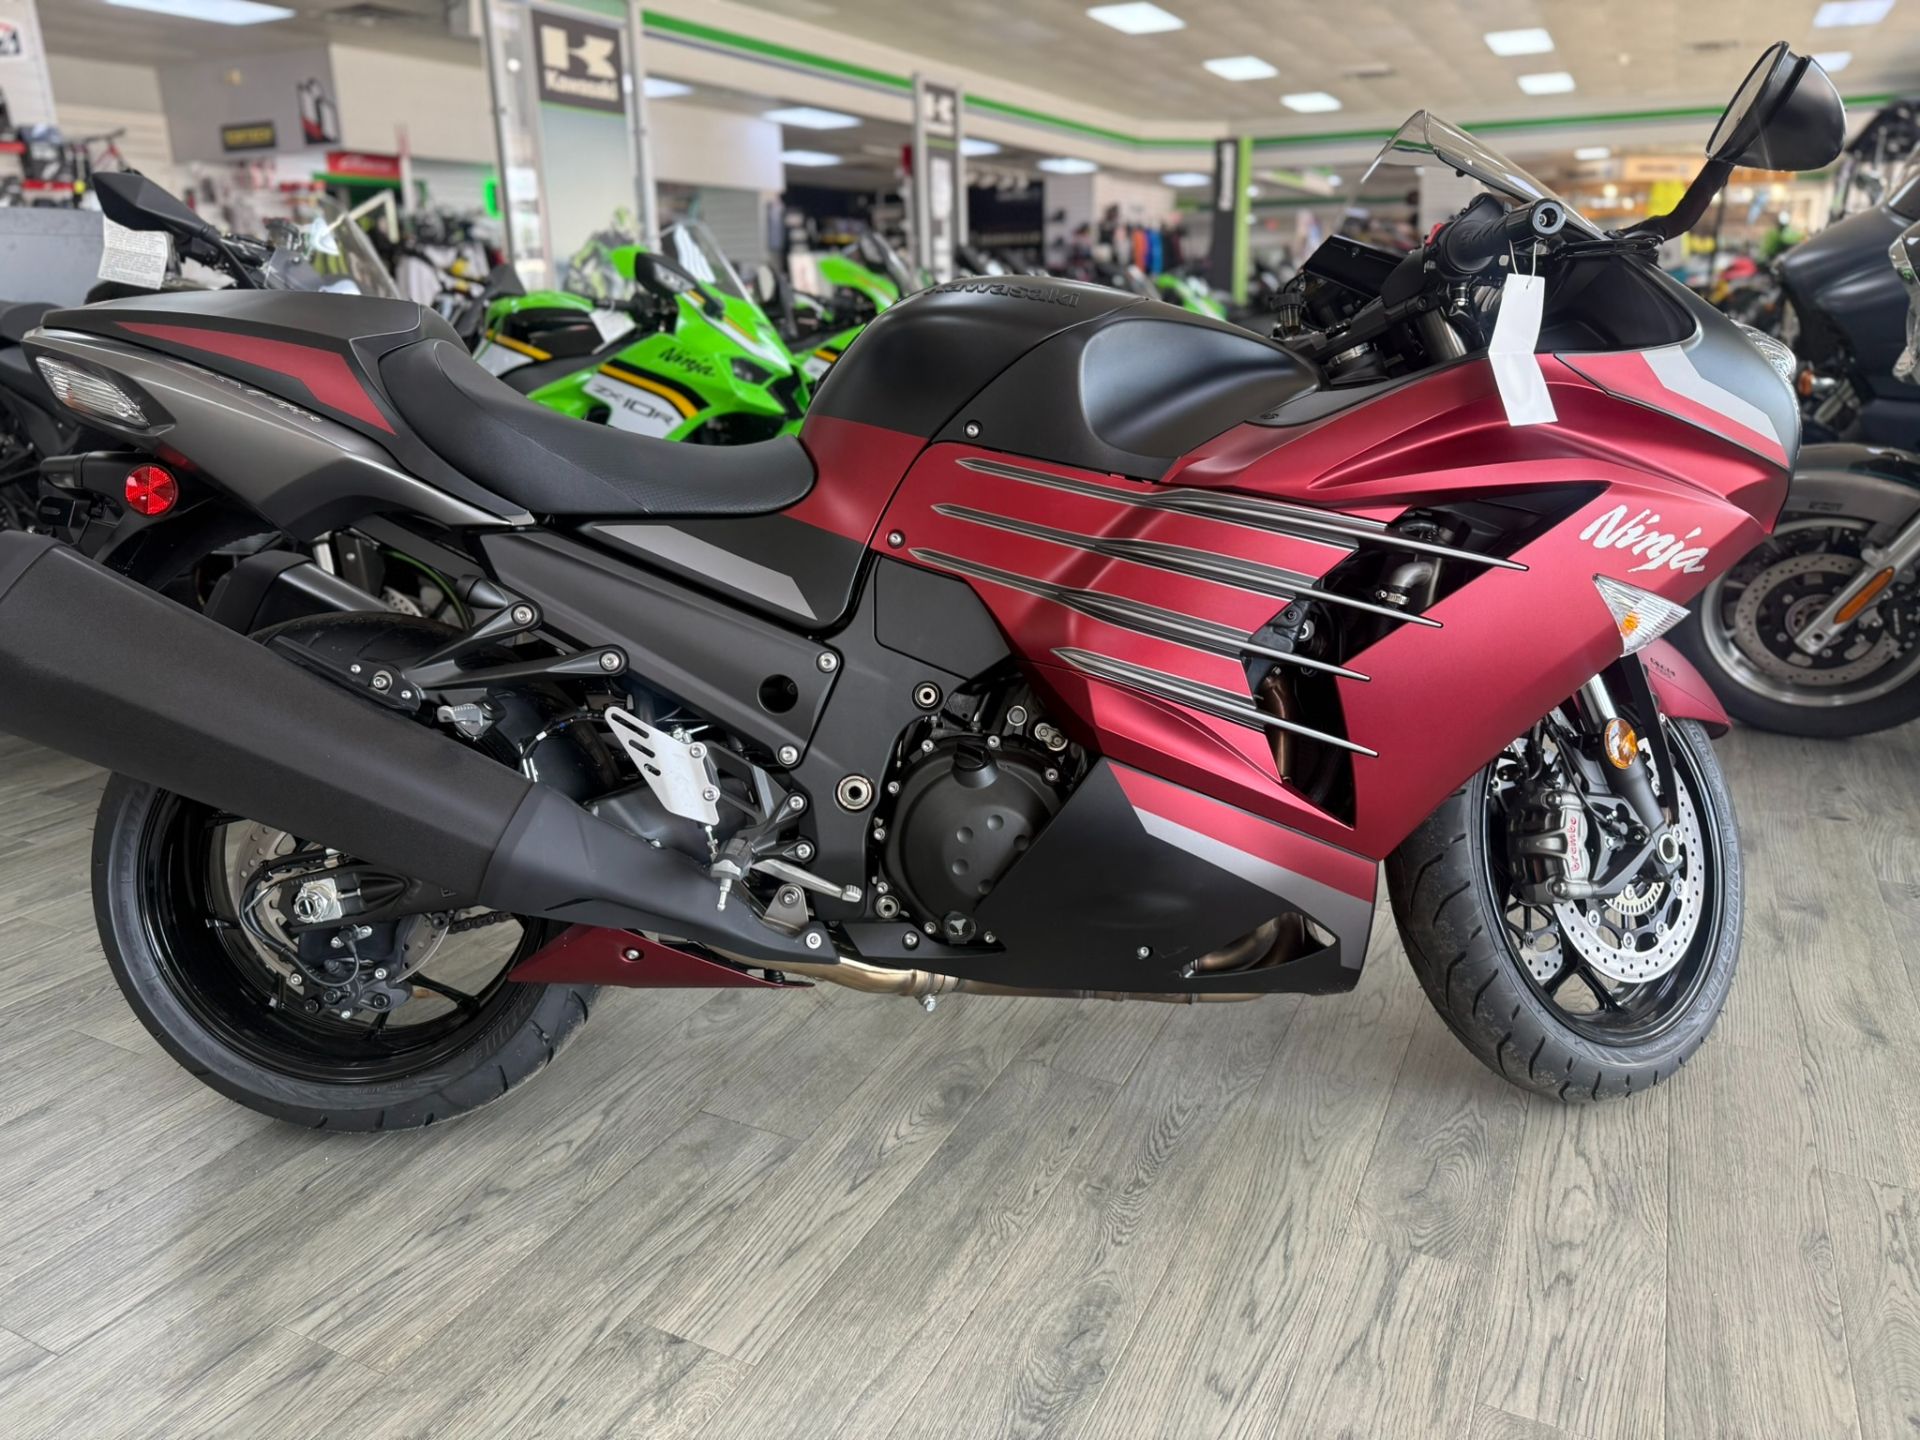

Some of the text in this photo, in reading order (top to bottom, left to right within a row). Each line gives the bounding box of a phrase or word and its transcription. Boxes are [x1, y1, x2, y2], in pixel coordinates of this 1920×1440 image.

[659, 348, 716, 378] Ninja
[1579, 504, 1709, 574] Ninja
[1567, 815, 1581, 873] brembo
